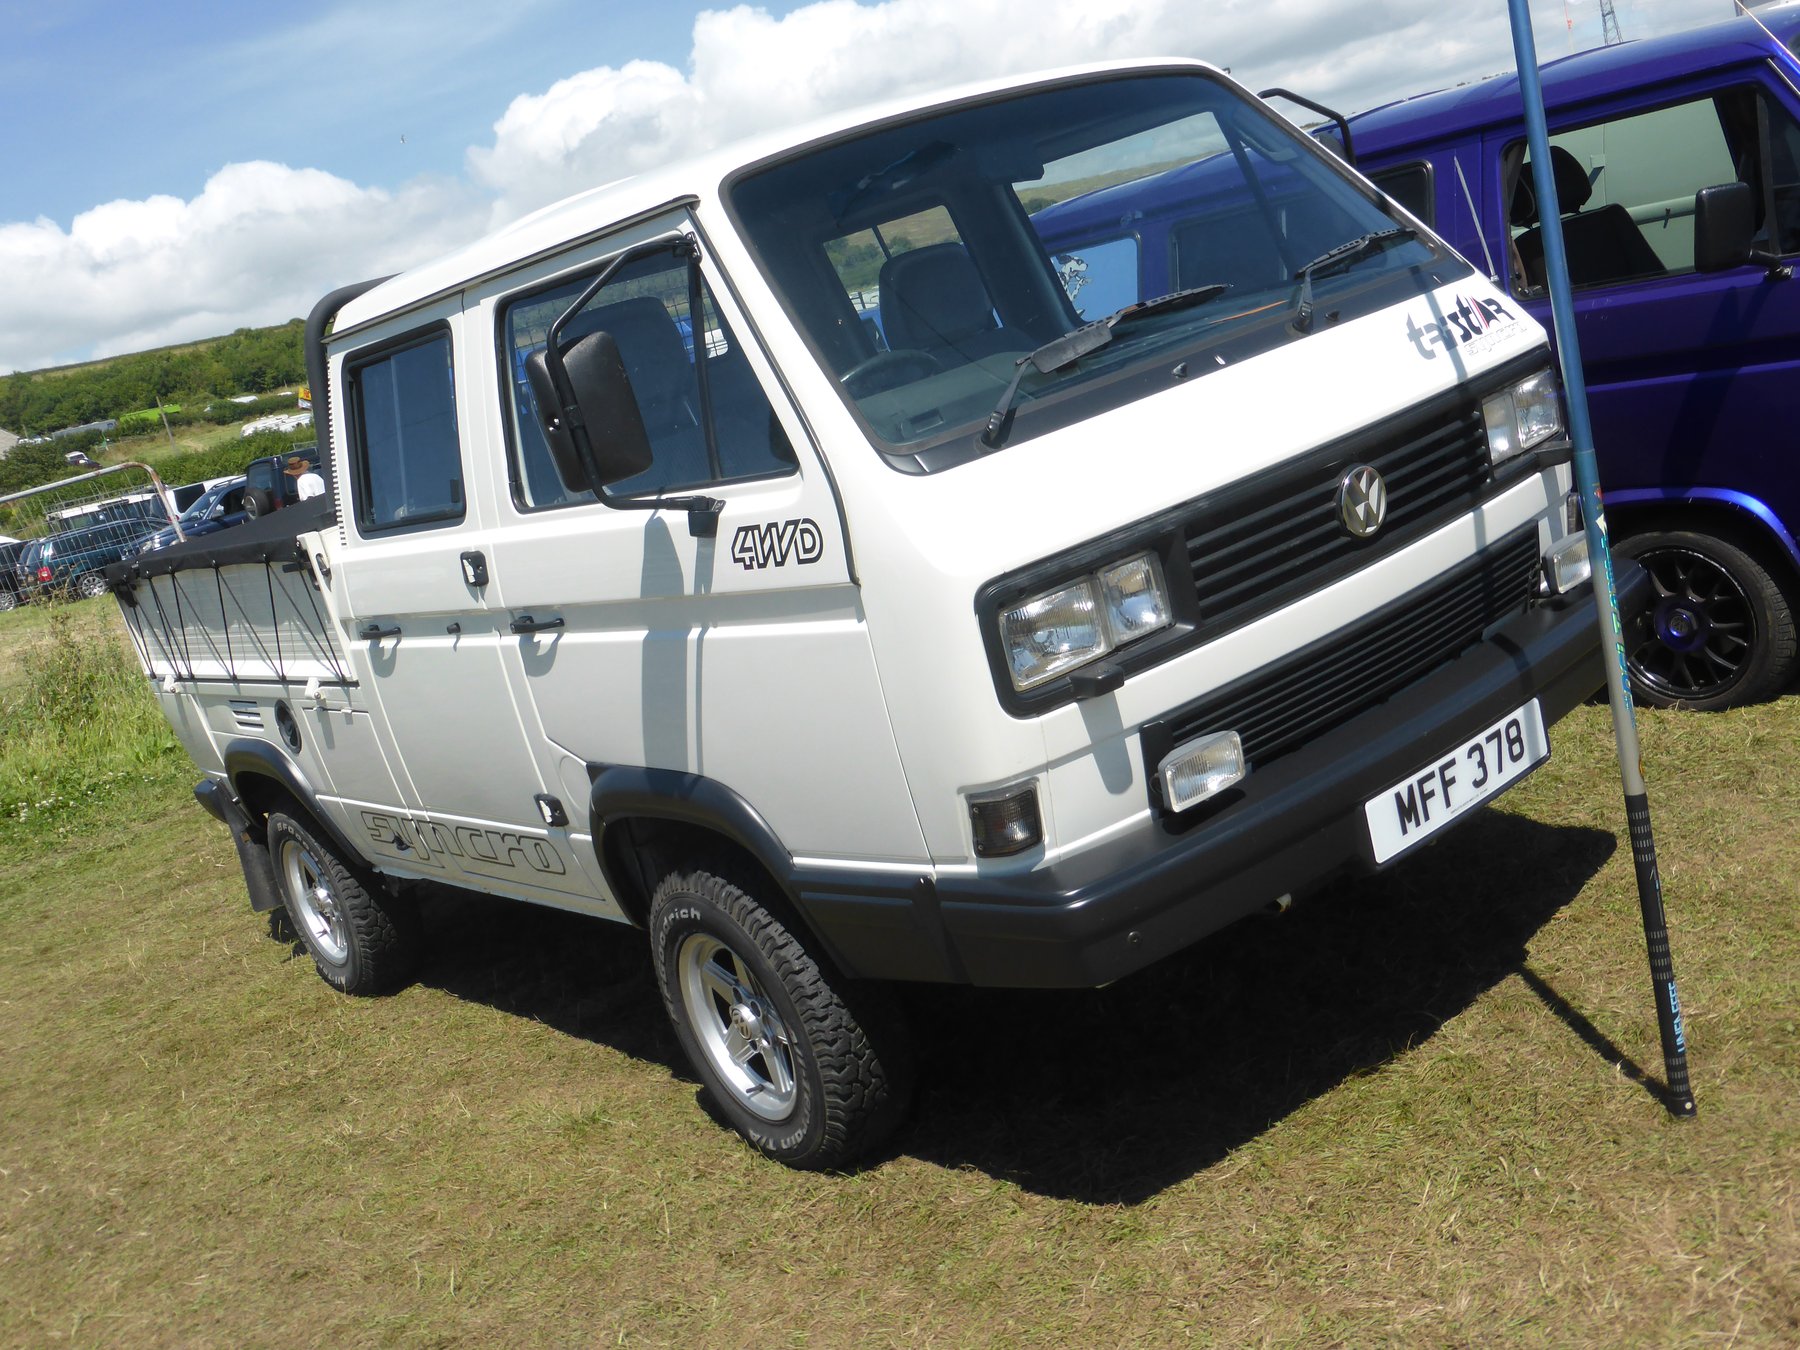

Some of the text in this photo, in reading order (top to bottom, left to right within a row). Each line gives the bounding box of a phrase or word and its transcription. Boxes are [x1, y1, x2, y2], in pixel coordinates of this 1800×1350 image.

[731, 518, 824, 571] 4WD
[1394, 718, 1525, 836] MFF 378
